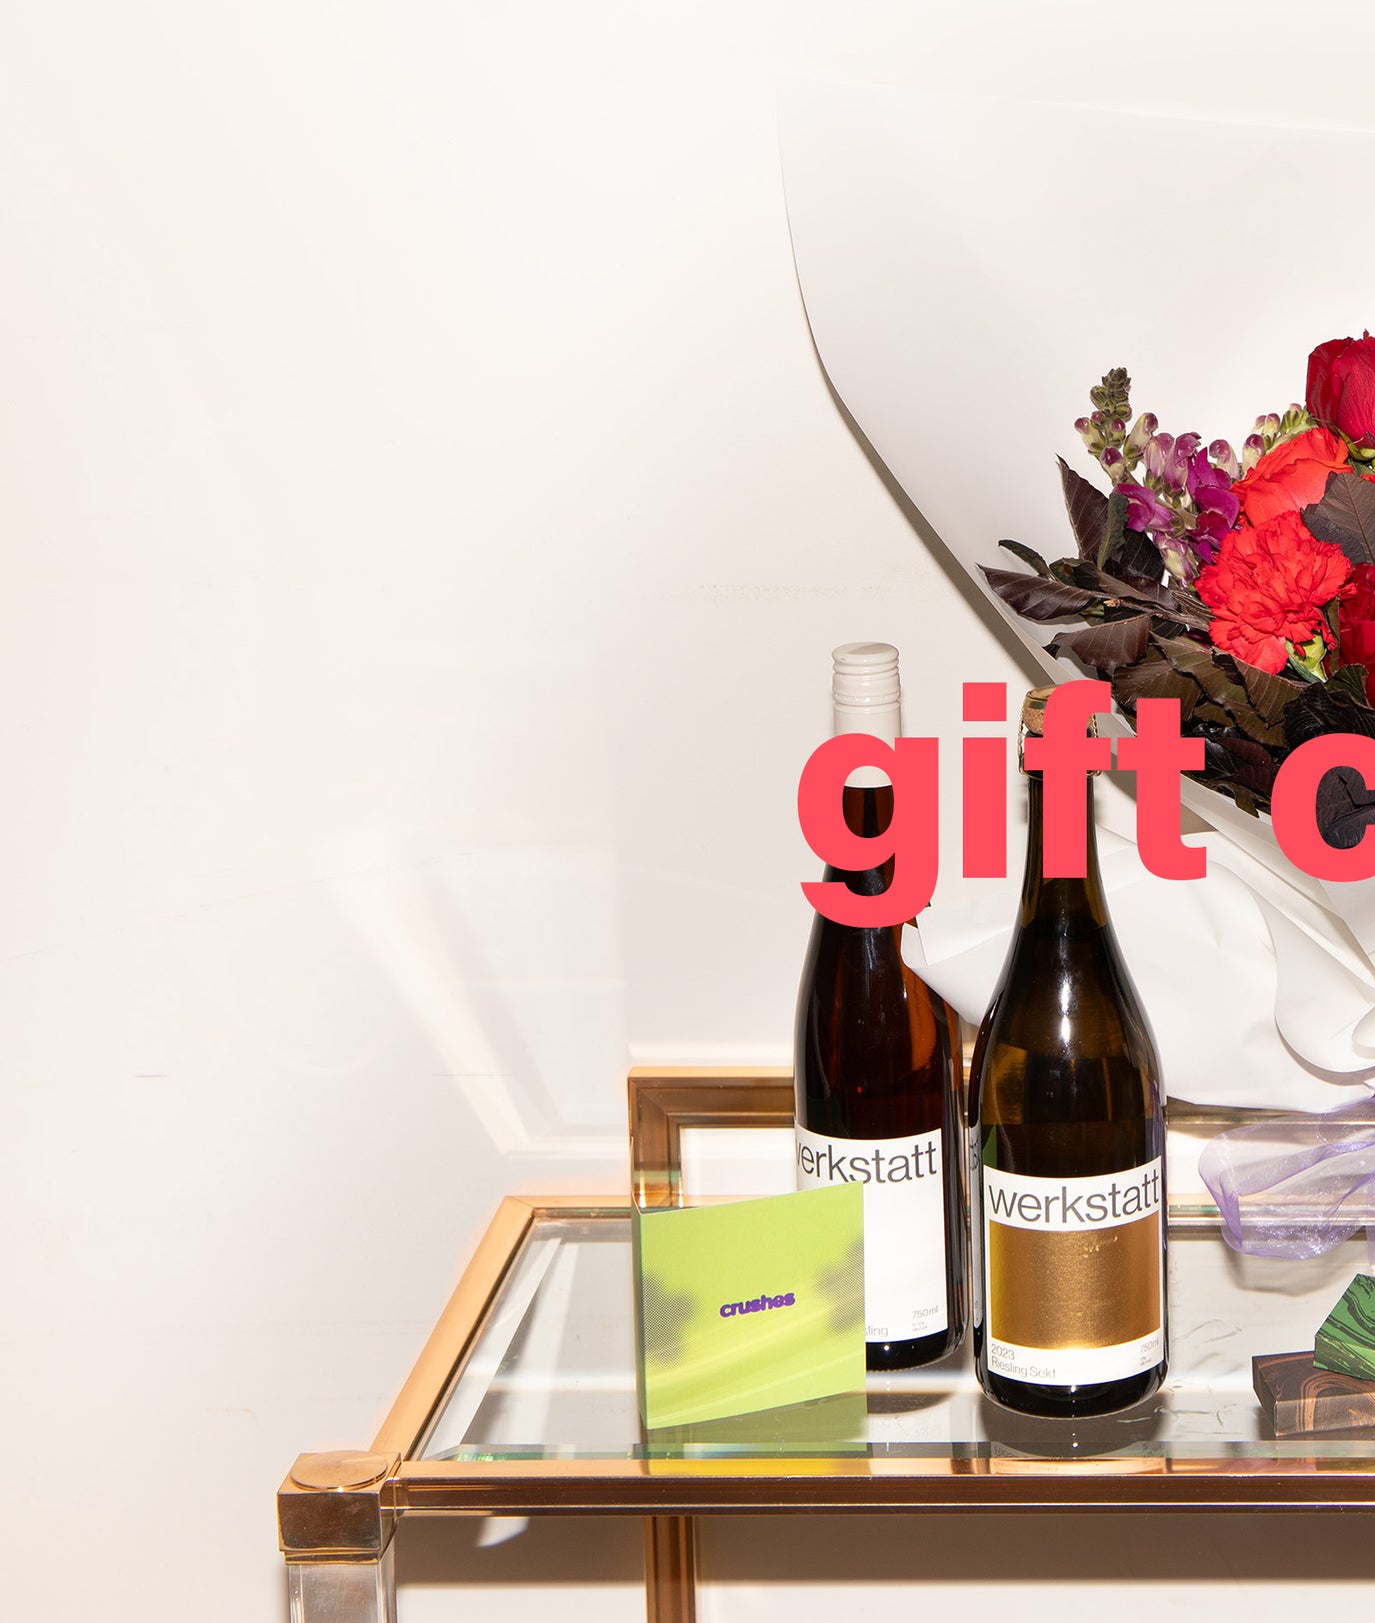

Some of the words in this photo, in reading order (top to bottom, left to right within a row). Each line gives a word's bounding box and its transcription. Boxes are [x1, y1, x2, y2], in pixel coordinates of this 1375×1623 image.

[988, 1168, 1160, 1223] werkstatt
[720, 1292, 796, 1318] crushes
[991, 1343, 1016, 1361] 2023
[991, 1356, 1028, 1378] Riesling
